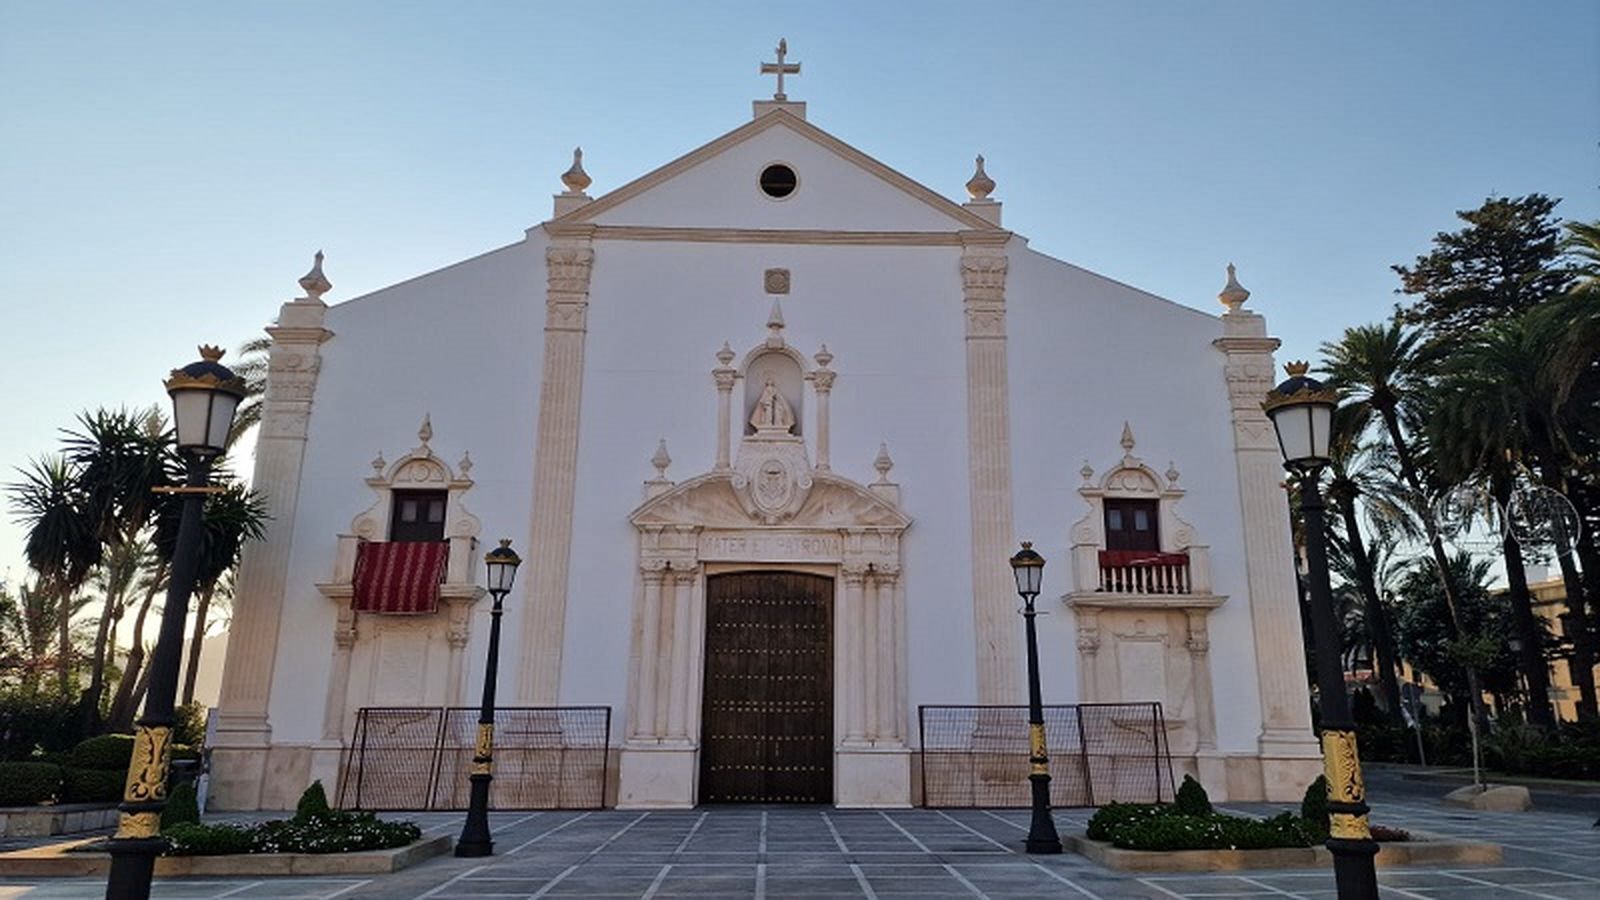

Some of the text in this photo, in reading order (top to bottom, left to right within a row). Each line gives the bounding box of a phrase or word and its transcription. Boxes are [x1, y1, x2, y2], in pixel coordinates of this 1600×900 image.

[702, 536, 839, 556] MATER ET PATRONA
